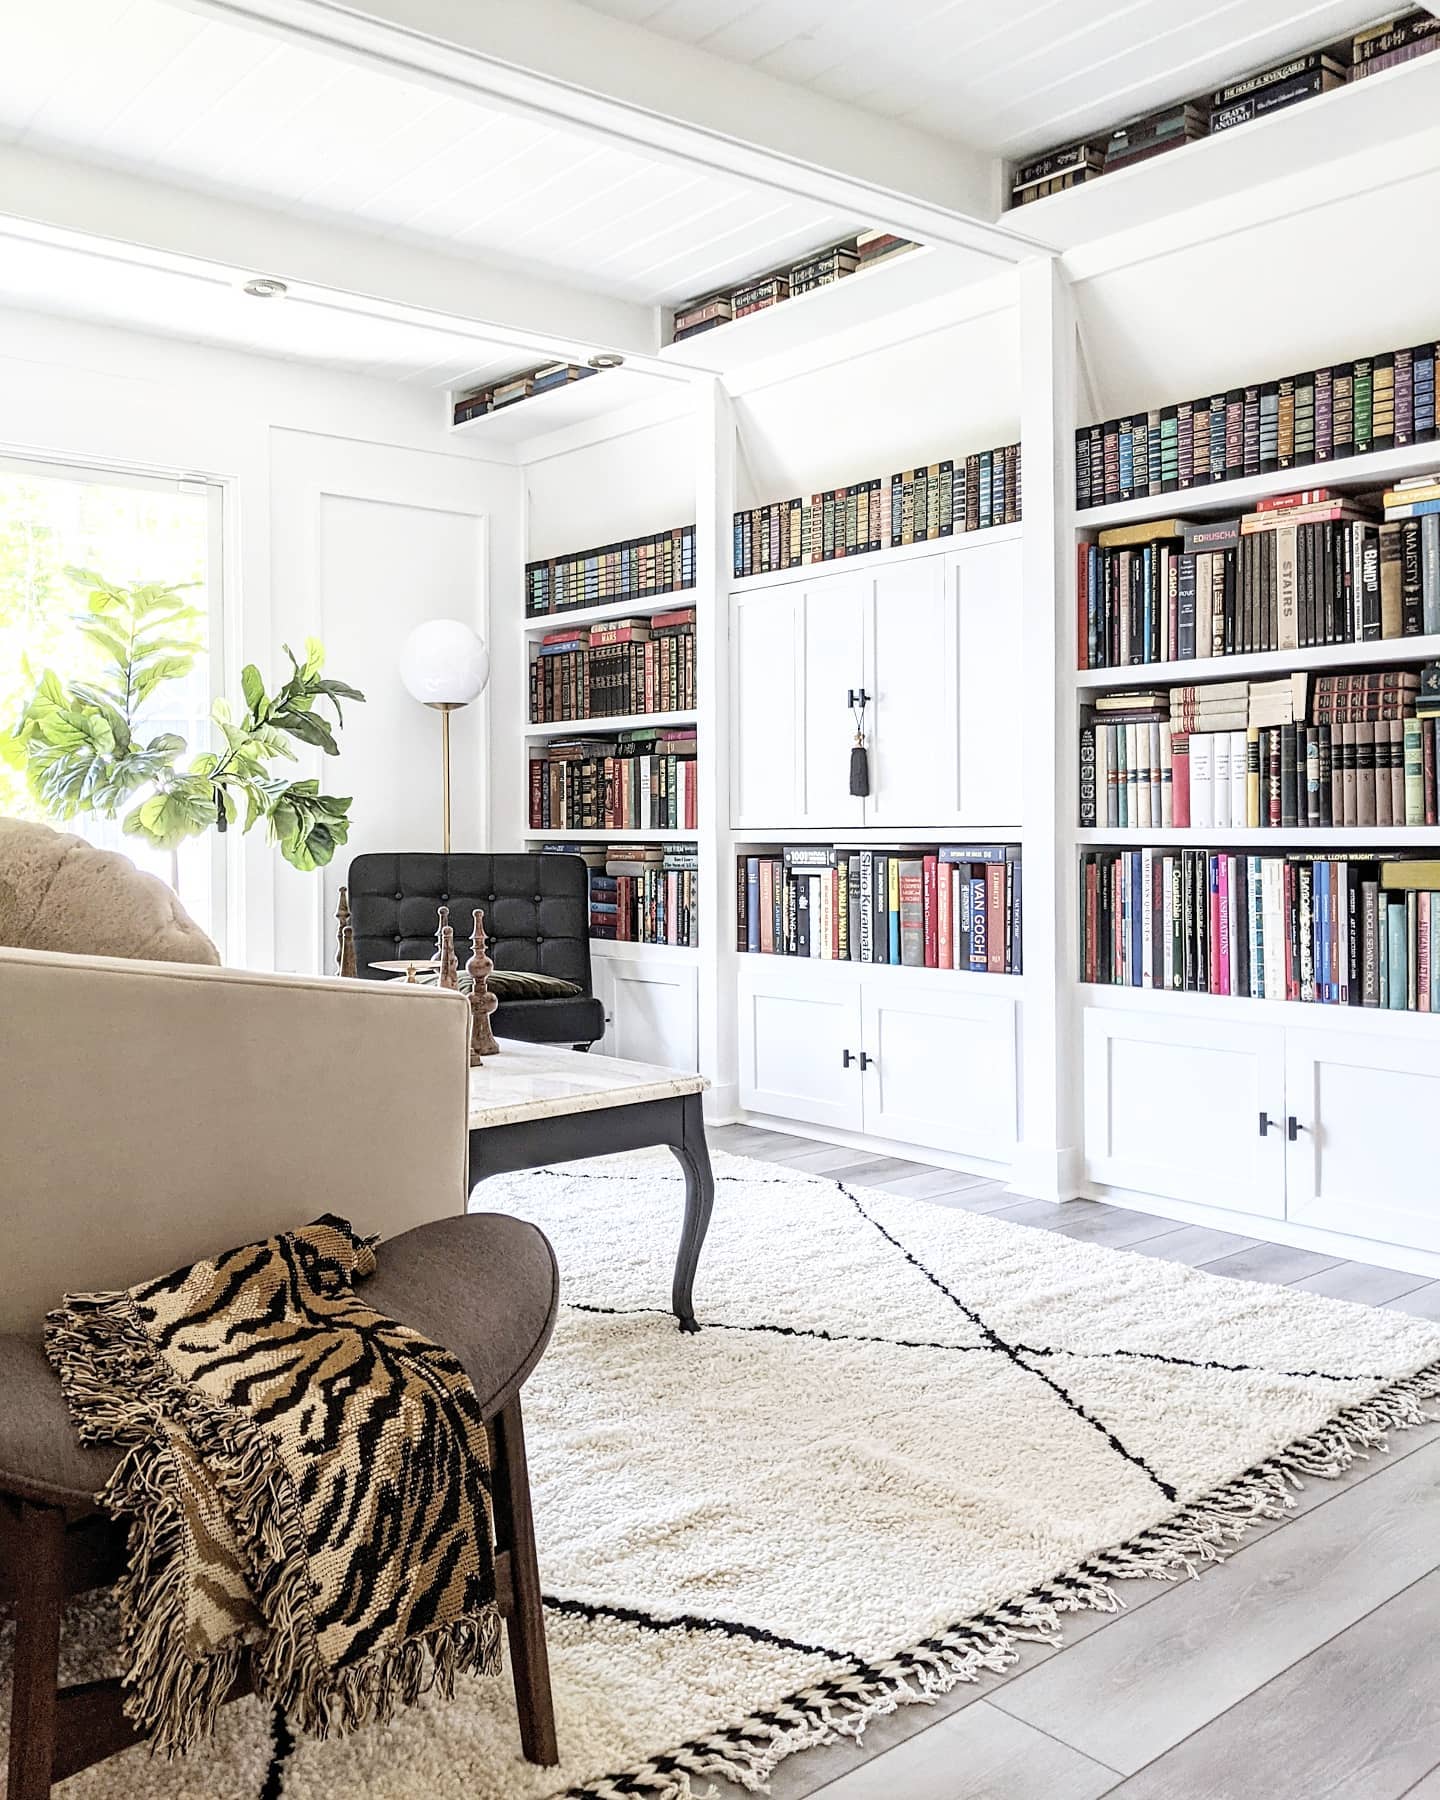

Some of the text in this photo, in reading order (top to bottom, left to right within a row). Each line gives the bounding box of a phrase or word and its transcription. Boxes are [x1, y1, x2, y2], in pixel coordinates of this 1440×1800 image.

[1214, 111, 1251, 132] ANATOMY
[1404, 531, 1418, 583] MAJESTY
[1169, 568, 1178, 598] OSHO
[1283, 561, 1293, 617] STAIRS
[788, 886, 796, 930] MUSTANG
[838, 880, 847, 917] WORLD
[861, 854, 871, 961] Shiro Kuramata
[974, 882, 985, 955] VAN GOGH
[1172, 869, 1181, 918] Constable
[838, 917, 847, 939] WAR
[1220, 895, 1228, 955] INSPIRATIONS
[1366, 891, 1374, 995] THE VOGUE SEWING BOOK
